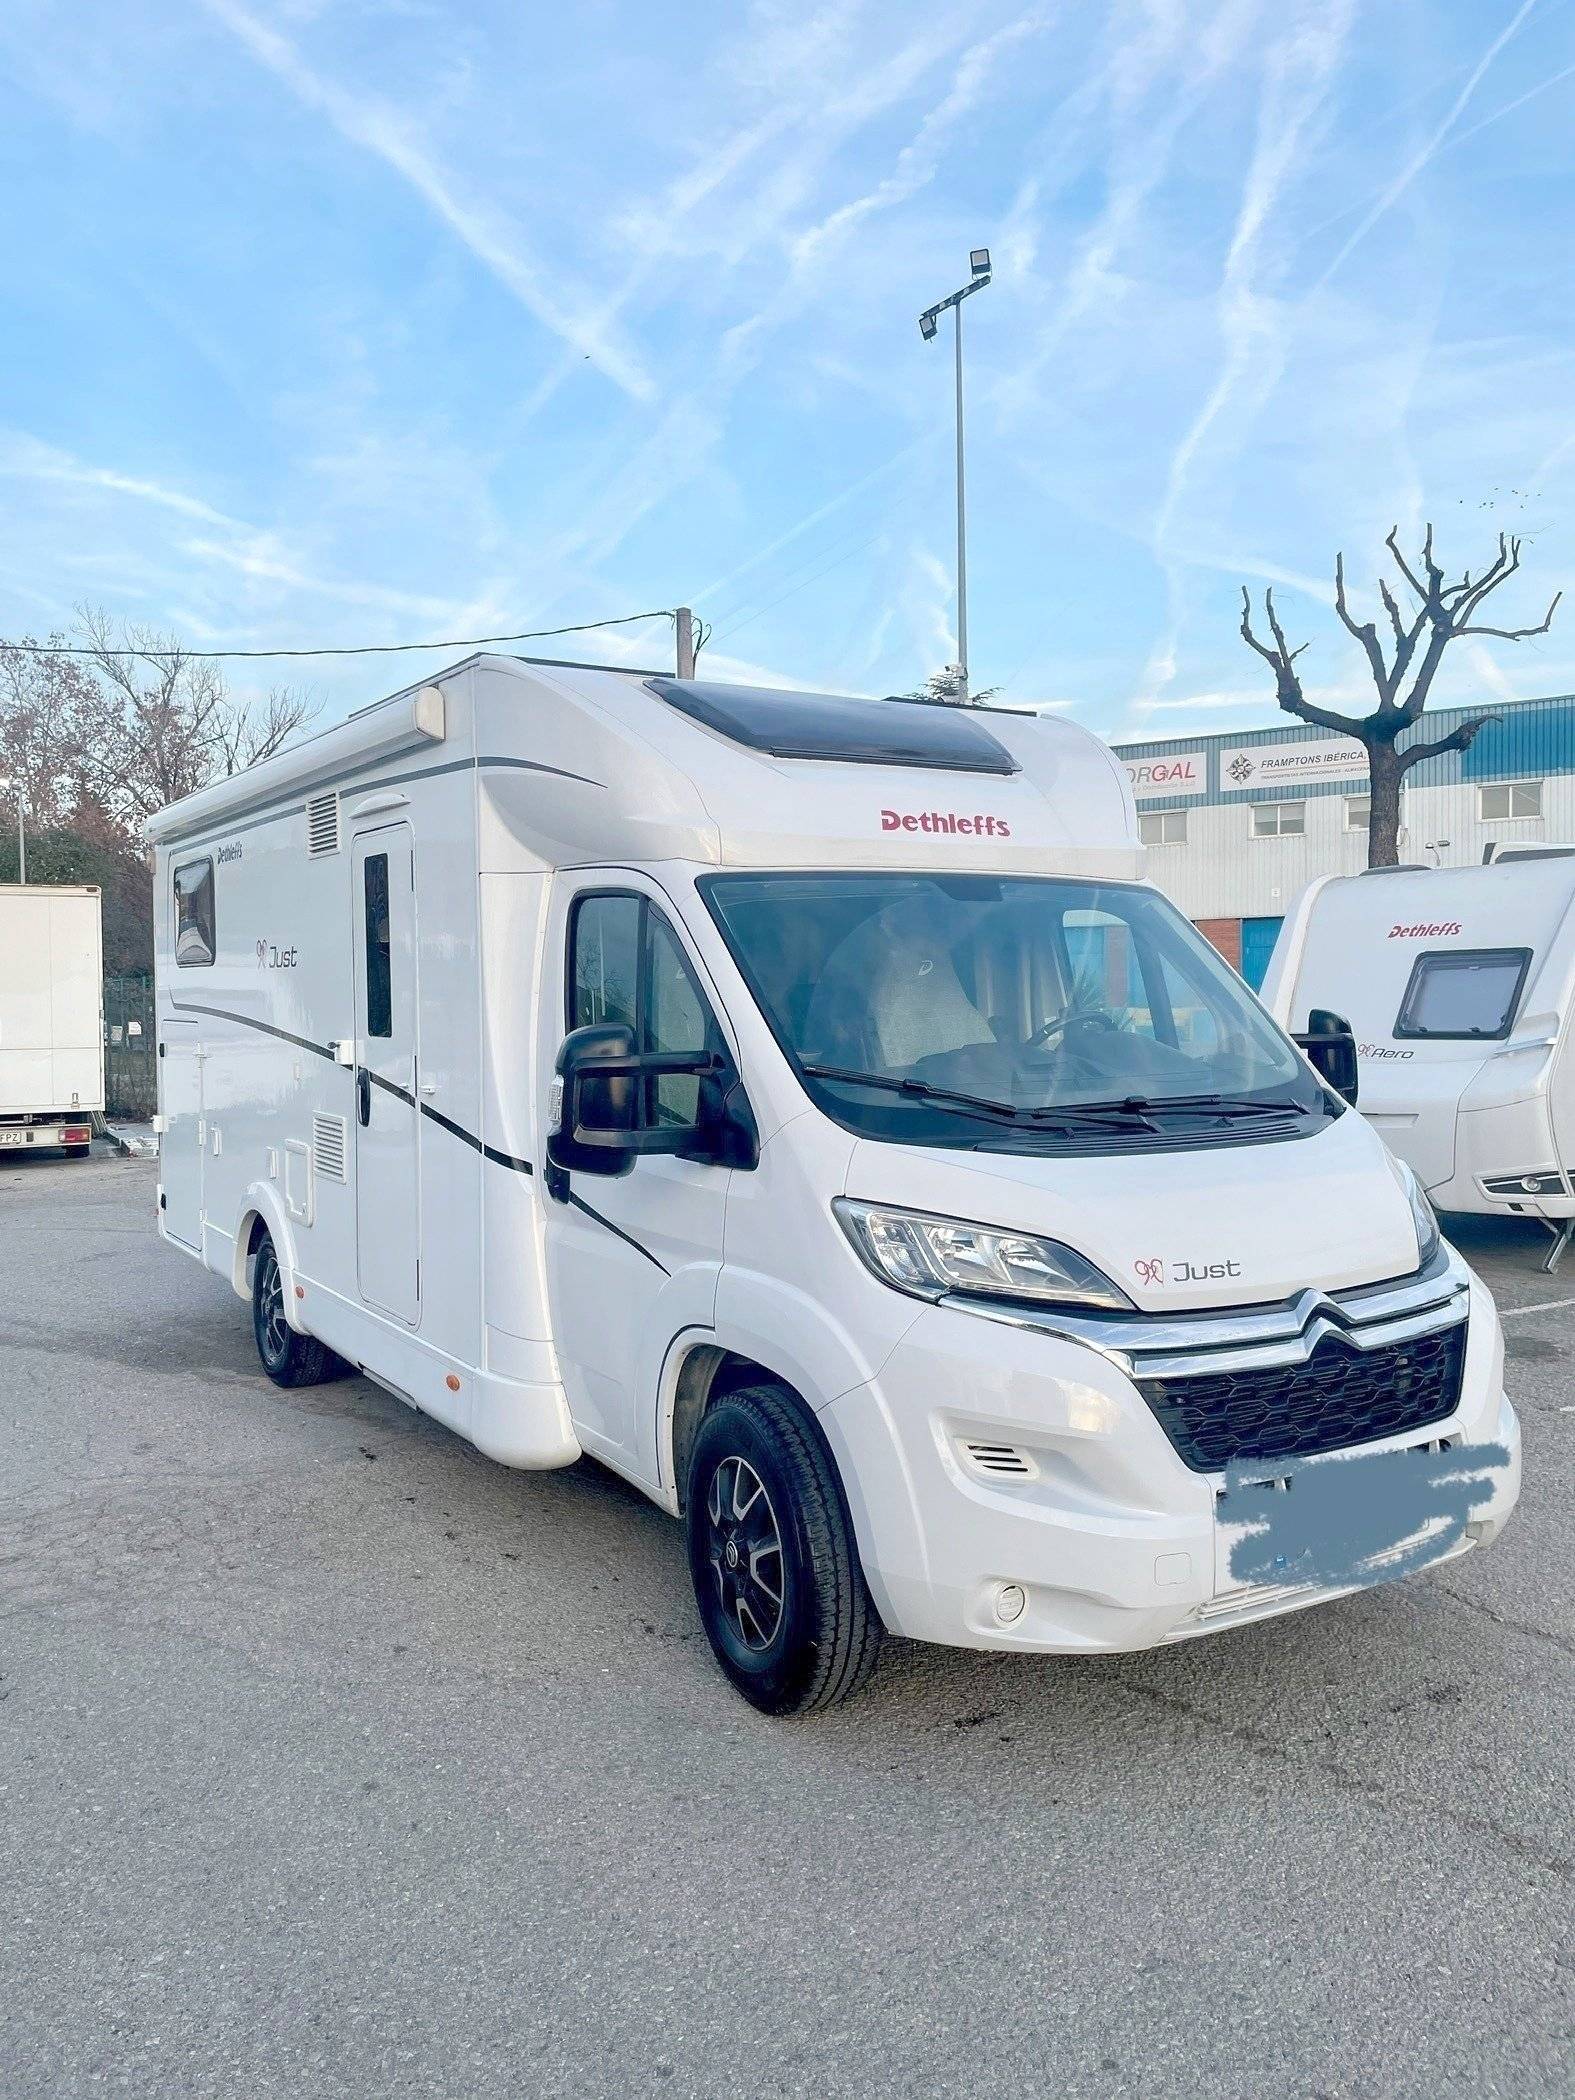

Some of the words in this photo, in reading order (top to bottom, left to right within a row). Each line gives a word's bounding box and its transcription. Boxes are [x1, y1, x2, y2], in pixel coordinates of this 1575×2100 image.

[1260, 754, 1321, 768] FRAMPTONS
[880, 809, 1011, 837] Dethleffs
[1387, 922, 1462, 938] Dethleffs
[269, 946, 298, 968] Just
[1370, 1048, 1415, 1059] Aero
[1172, 1260, 1241, 1282] Just
